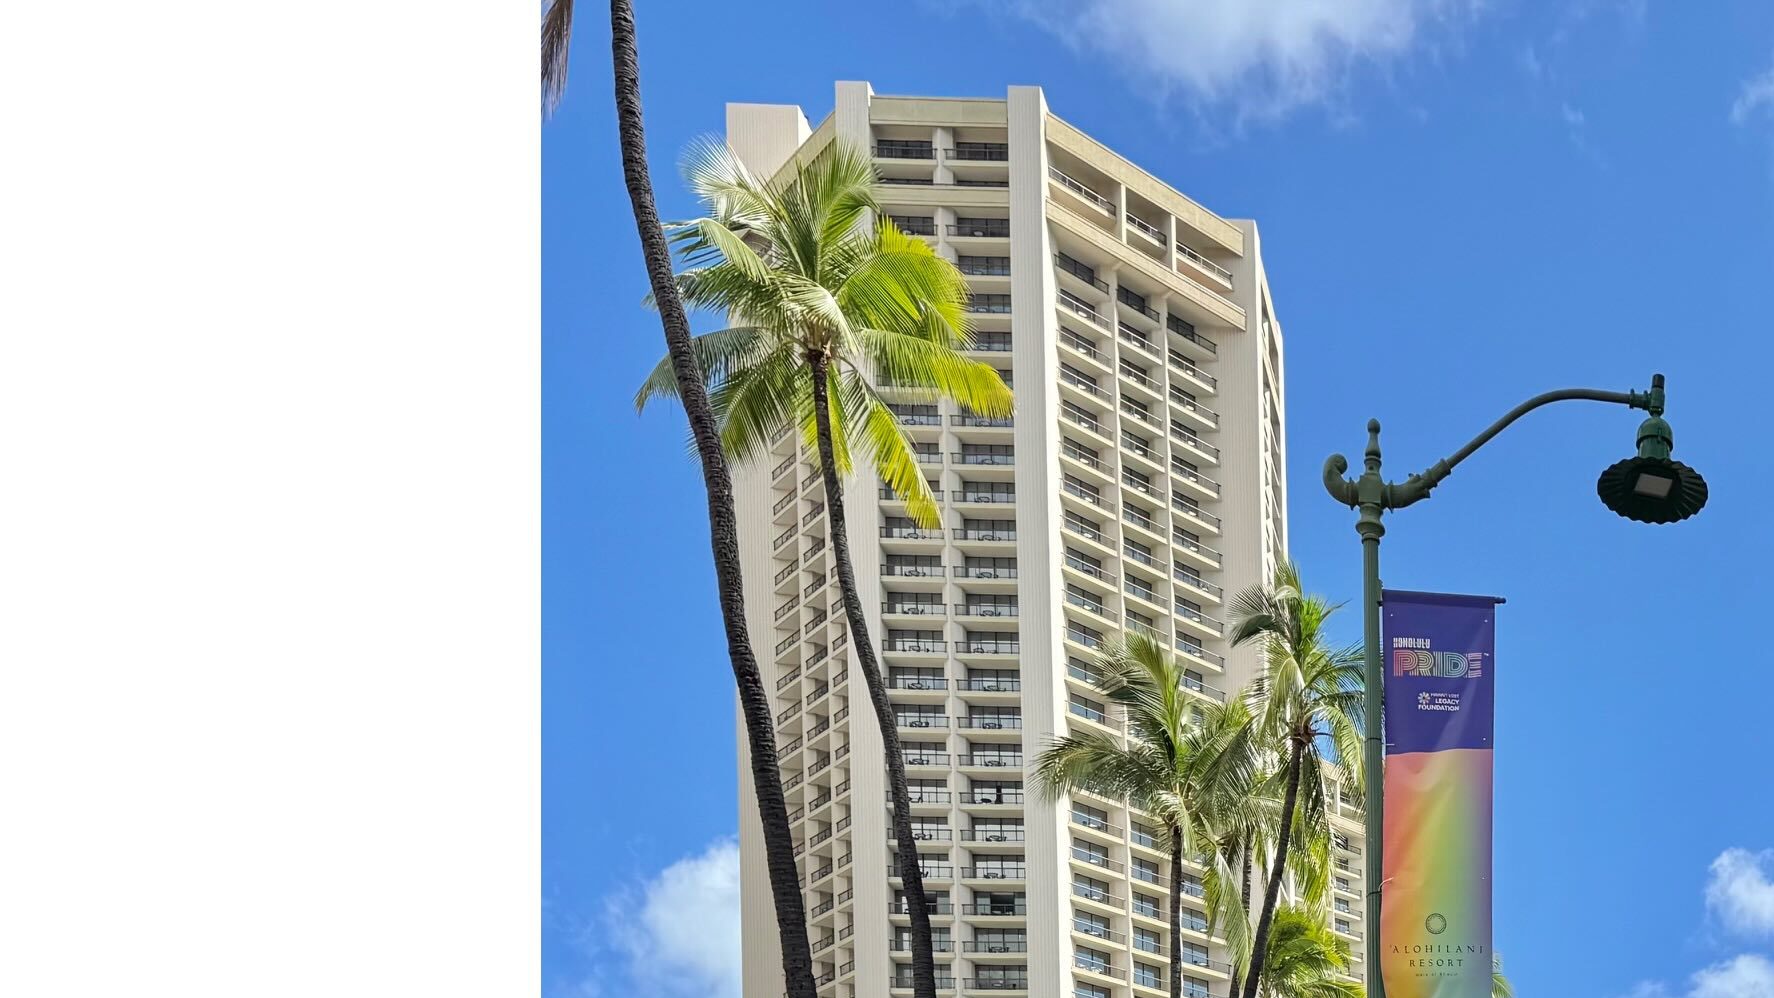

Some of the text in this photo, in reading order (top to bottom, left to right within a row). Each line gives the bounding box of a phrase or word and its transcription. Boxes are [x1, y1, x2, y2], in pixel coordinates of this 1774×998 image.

[1392, 637, 1431, 649] HONOLULU
[1393, 649, 1482, 678] PRIDE
[1409, 959, 1464, 968] RESORT
